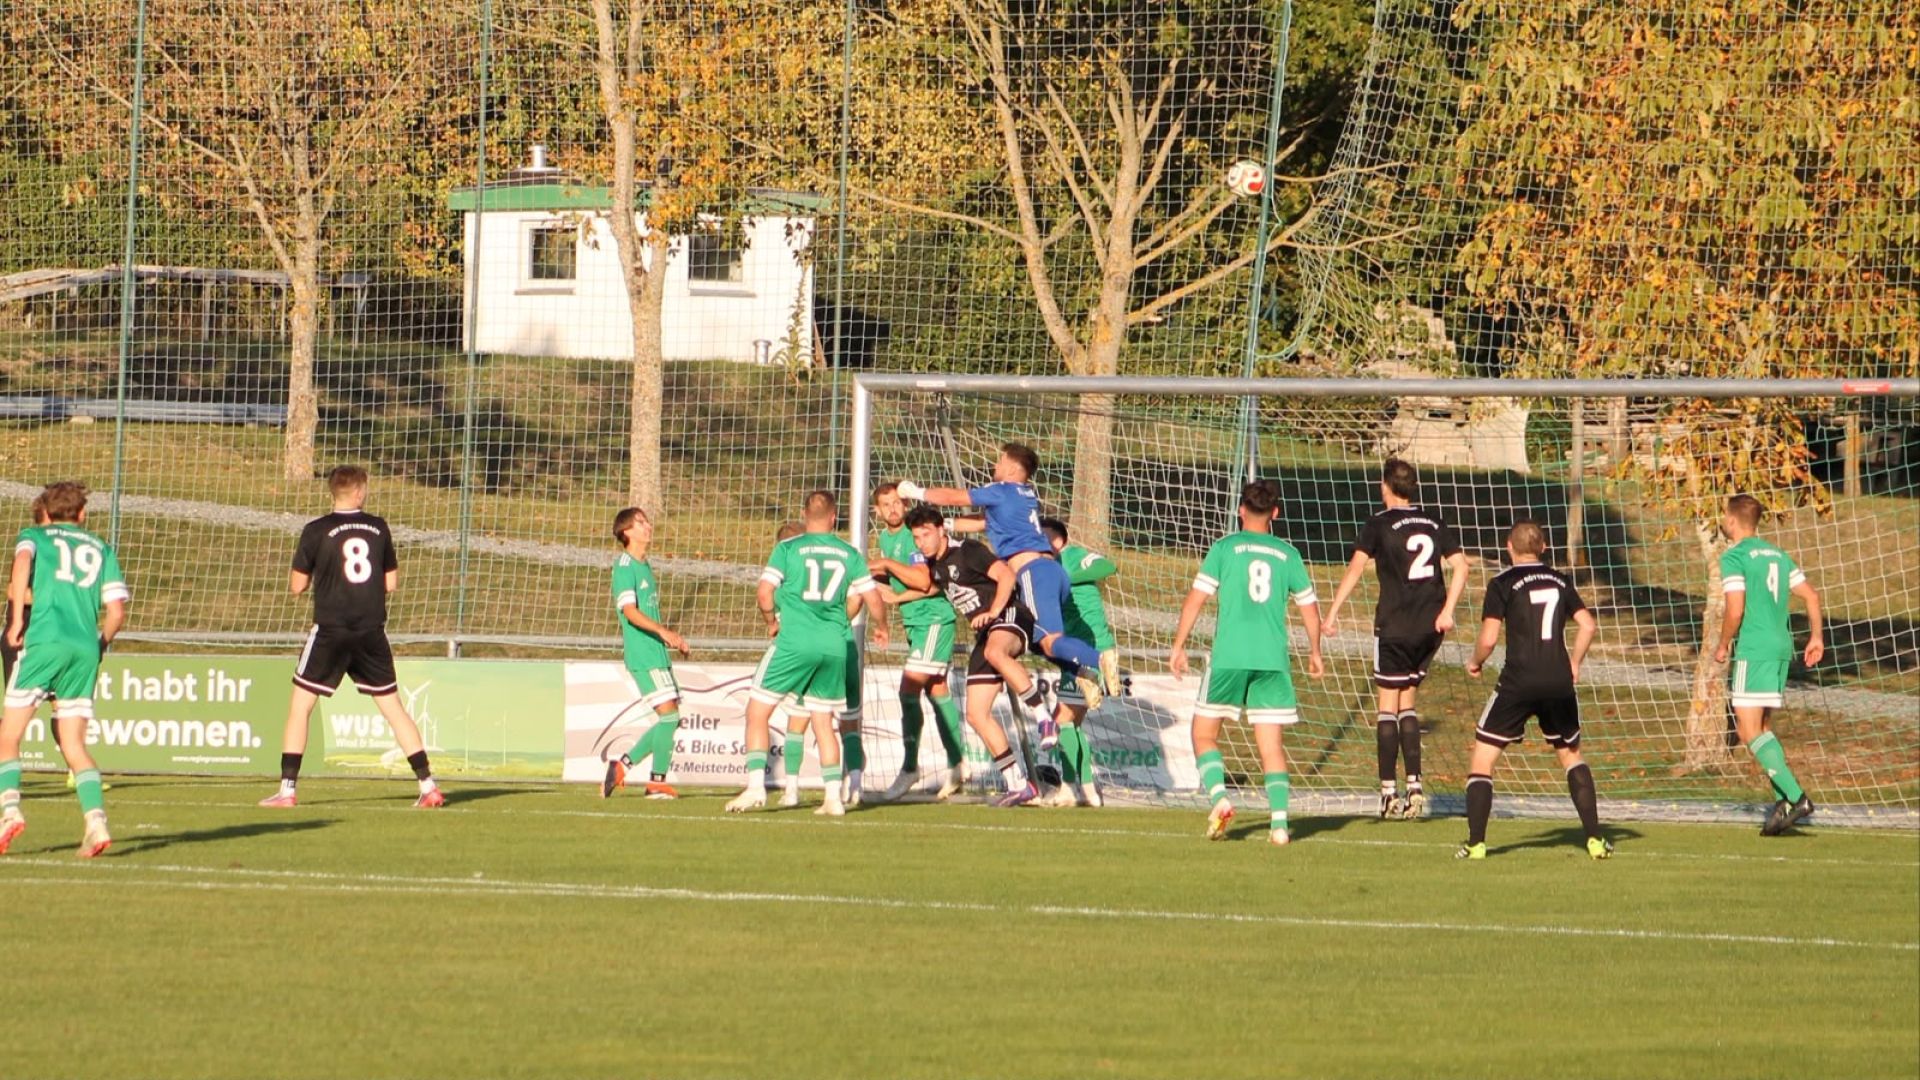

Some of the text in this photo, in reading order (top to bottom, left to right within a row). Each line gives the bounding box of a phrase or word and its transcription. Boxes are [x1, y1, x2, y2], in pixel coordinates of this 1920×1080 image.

[53, 538, 103, 588] 19
[343, 537, 371, 583] 8
[1406, 534, 1434, 580] 2
[802, 558, 846, 601] 17
[1248, 559, 1272, 603] 8
[1766, 562, 1779, 604] 4
[1529, 588, 1560, 640] 7
[122, 669, 198, 701] habt
[208, 668, 251, 702] ihr
[57, 716, 261, 751] ewonnen.
[680, 713, 720, 730] eiler
[691, 740, 727, 755] Bike
[731, 740, 784, 756] Sece
